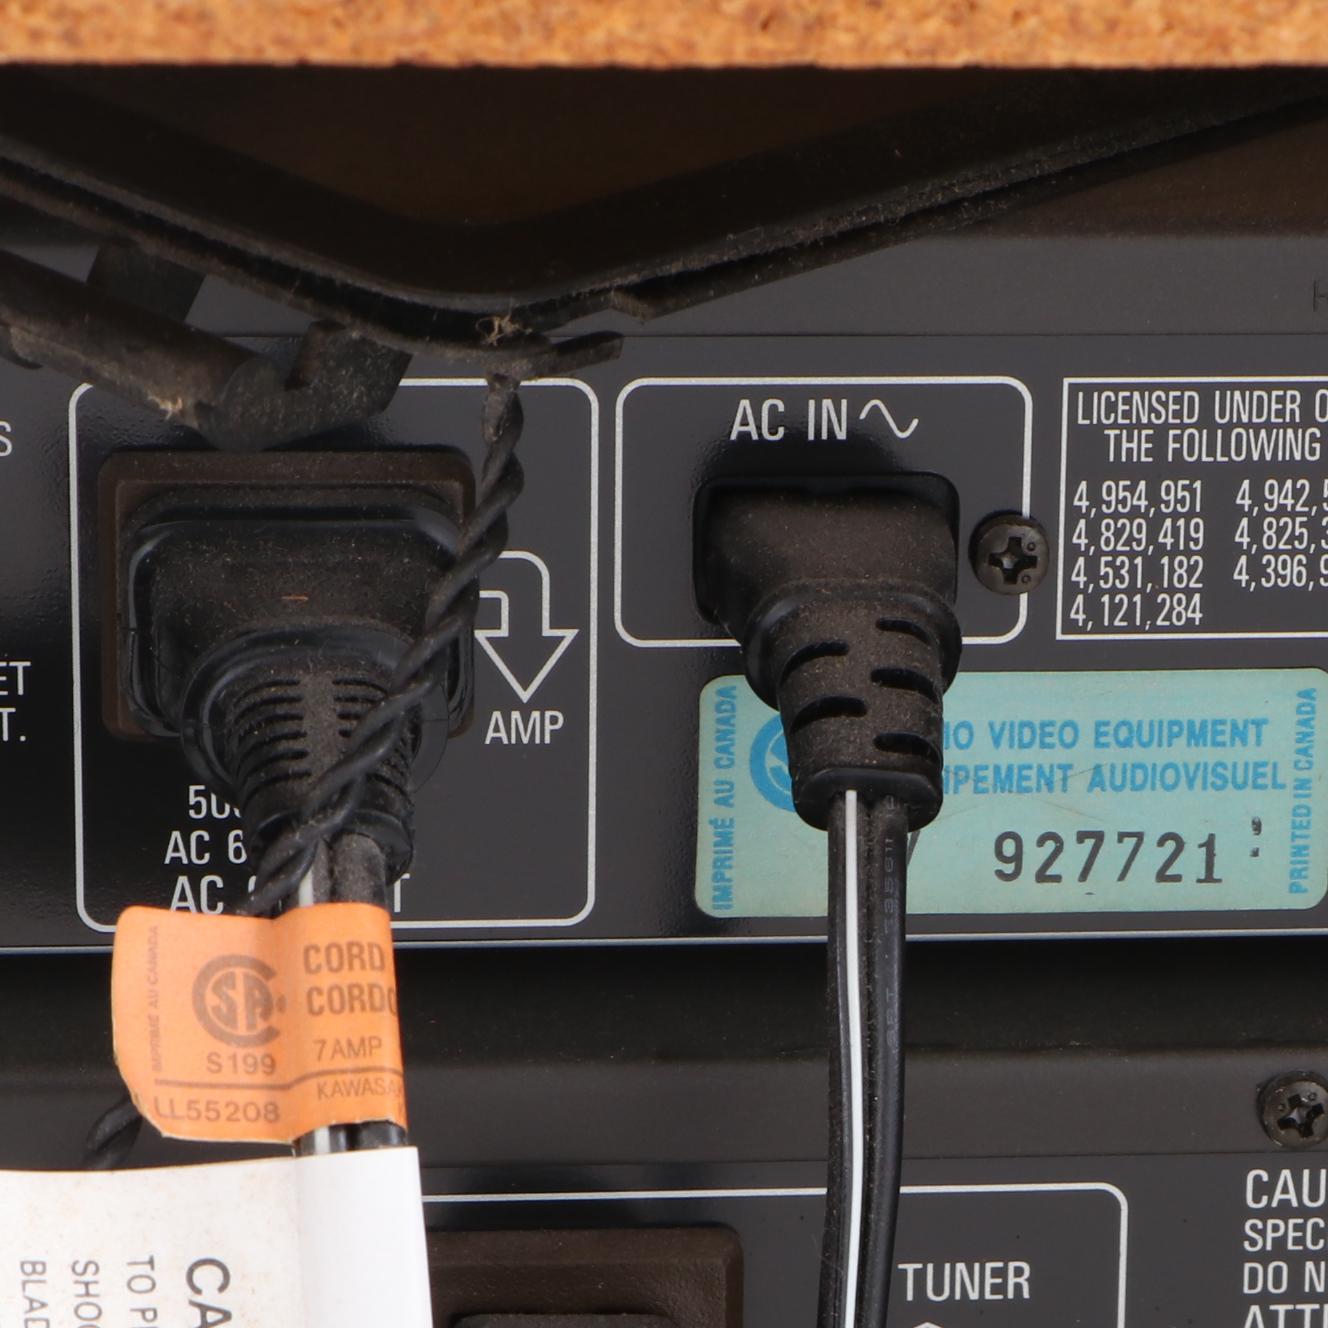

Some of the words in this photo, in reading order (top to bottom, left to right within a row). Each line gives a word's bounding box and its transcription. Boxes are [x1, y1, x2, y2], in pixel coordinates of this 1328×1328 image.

[731, 399, 784, 440] AC
[809, 399, 847, 440] IN
[1078, 391, 1199, 424] LICENSED
[1215, 390, 1300, 423] UNDER
[1104, 429, 1153, 462] THE
[1168, 428, 1320, 461] FOLLOWING
[1073, 480, 1201, 518] 4,954,951
[1072, 518, 1204, 555] 4,829,419
[1071, 556, 1203, 593] 4,531,182
[1070, 593, 1203, 631] 4,121,284
[485, 711, 563, 744] AMP
[715, 686, 736, 768] CANADA
[989, 720, 1079, 749] VIDEO
[1094, 719, 1268, 748] EQUIPMENT
[714, 780, 734, 807] AU
[1088, 762, 1286, 793] AUDIOVISUEL
[995, 831, 1222, 883] 927721
[303, 942, 385, 974] CORD
[126, 1255, 156, 1294] TO
[898, 1261, 1030, 1301] TUNER
[1243, 1261, 1288, 1294] DO
